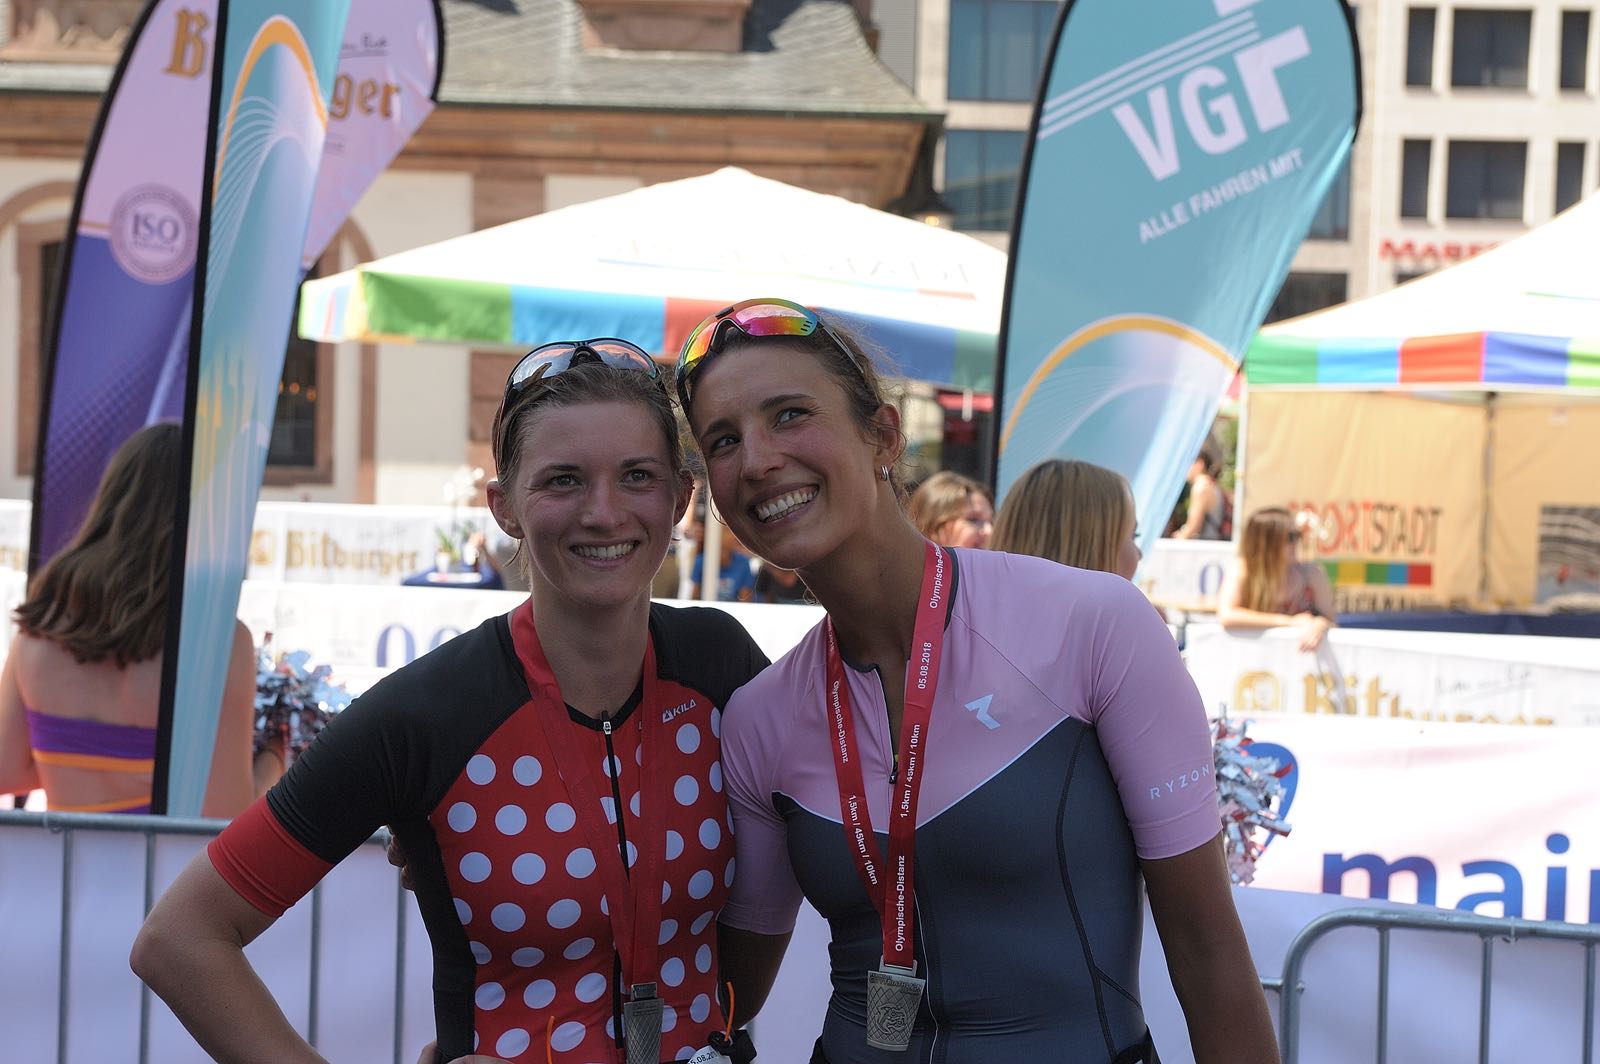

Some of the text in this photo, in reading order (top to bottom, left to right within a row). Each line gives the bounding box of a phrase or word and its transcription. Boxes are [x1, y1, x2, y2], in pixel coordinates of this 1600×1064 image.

[132, 212, 180, 243] ISO
[1138, 147, 1304, 244] ALLE FAHREN MIT
[917, 642, 932, 690] 05.08.2018
[831, 680, 849, 764] Olympische-Distanz
[900, 790, 911, 818] 1,5km
[910, 724, 921, 749] 10km
[1150, 764, 1210, 800] RYZON
[854, 827, 867, 854] 45km
[864, 859, 878, 886] 10km
[1322, 833, 1600, 925] mai
[895, 855, 906, 952] Olympische-Distanz
